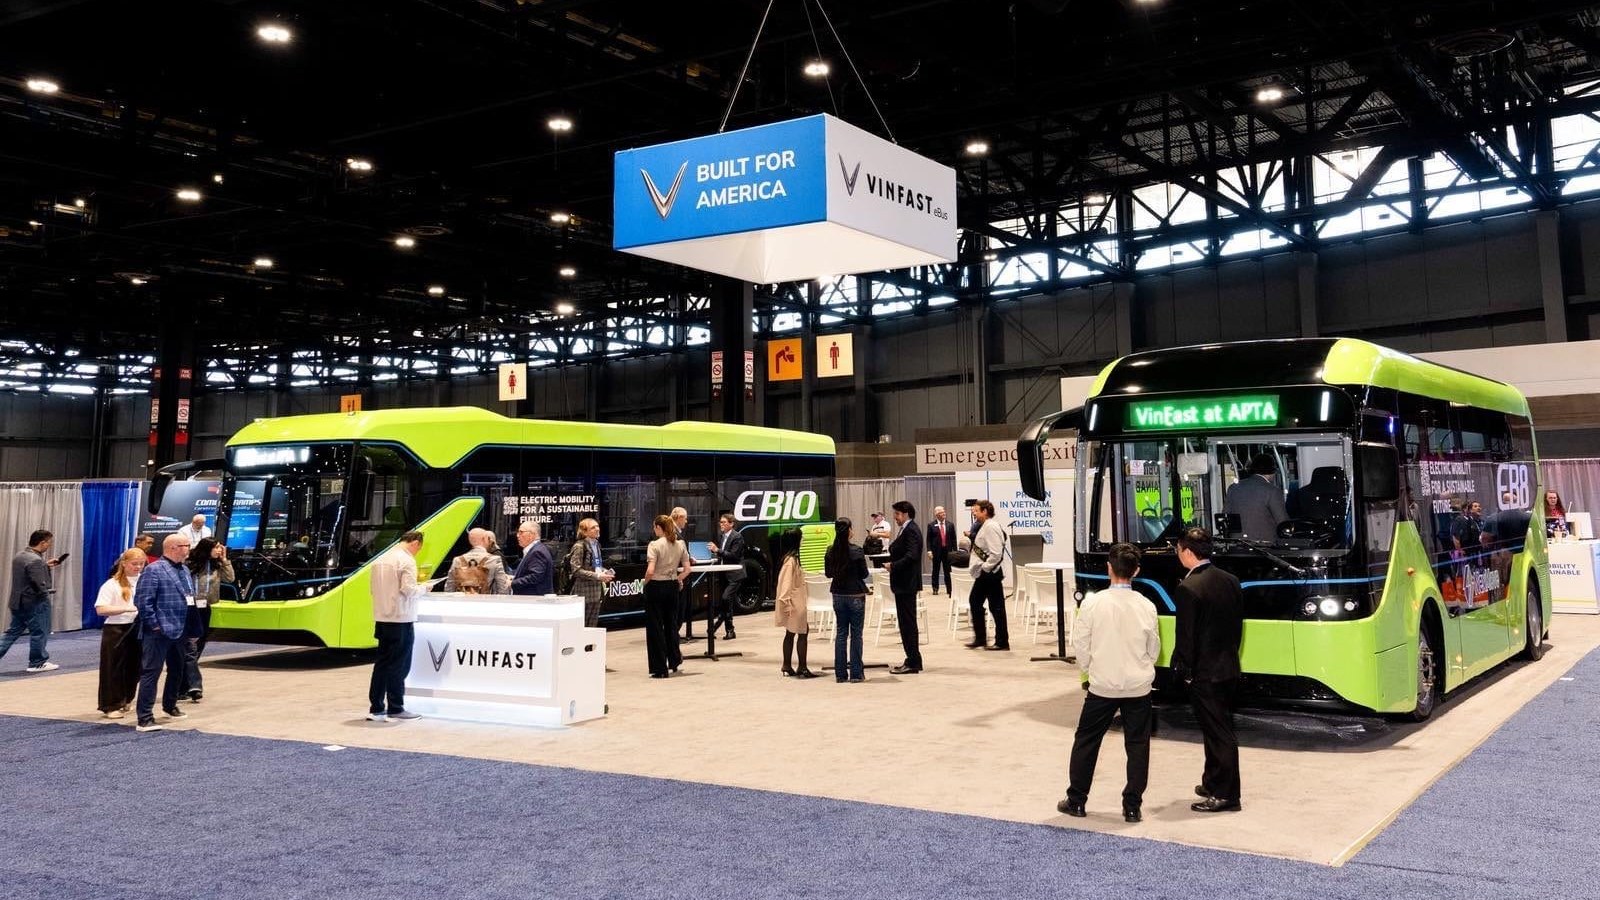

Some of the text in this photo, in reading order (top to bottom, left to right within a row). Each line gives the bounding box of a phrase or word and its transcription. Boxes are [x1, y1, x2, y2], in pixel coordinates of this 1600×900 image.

[697, 150, 796, 182] BUILT FOR
[696, 180, 787, 209] AMERICA
[867, 173, 948, 220] VINFAST eBus
[1204, 405, 1223, 423] at
[1228, 401, 1278, 422] APTA
[925, 441, 1077, 467] Emergenc Exit
[1430, 461, 1471, 475] ELECTRIC MOBILITY
[1431, 480, 1440, 494] FOR
[1447, 480, 1475, 493] SUSTAINABLE
[1497, 463, 1529, 511] EB8
[520, 495, 595, 504] ELECTRIC MOBILITY
[520, 506, 537, 514] FOR
[547, 505, 599, 513] SUSTAINABLE
[734, 491, 817, 521] EB10
[520, 516, 554, 524] FUTURE.
[1013, 520, 1053, 528] AMERICA.
[1035, 510, 1052, 518] FOR
[456, 649, 537, 670] VINFAST
